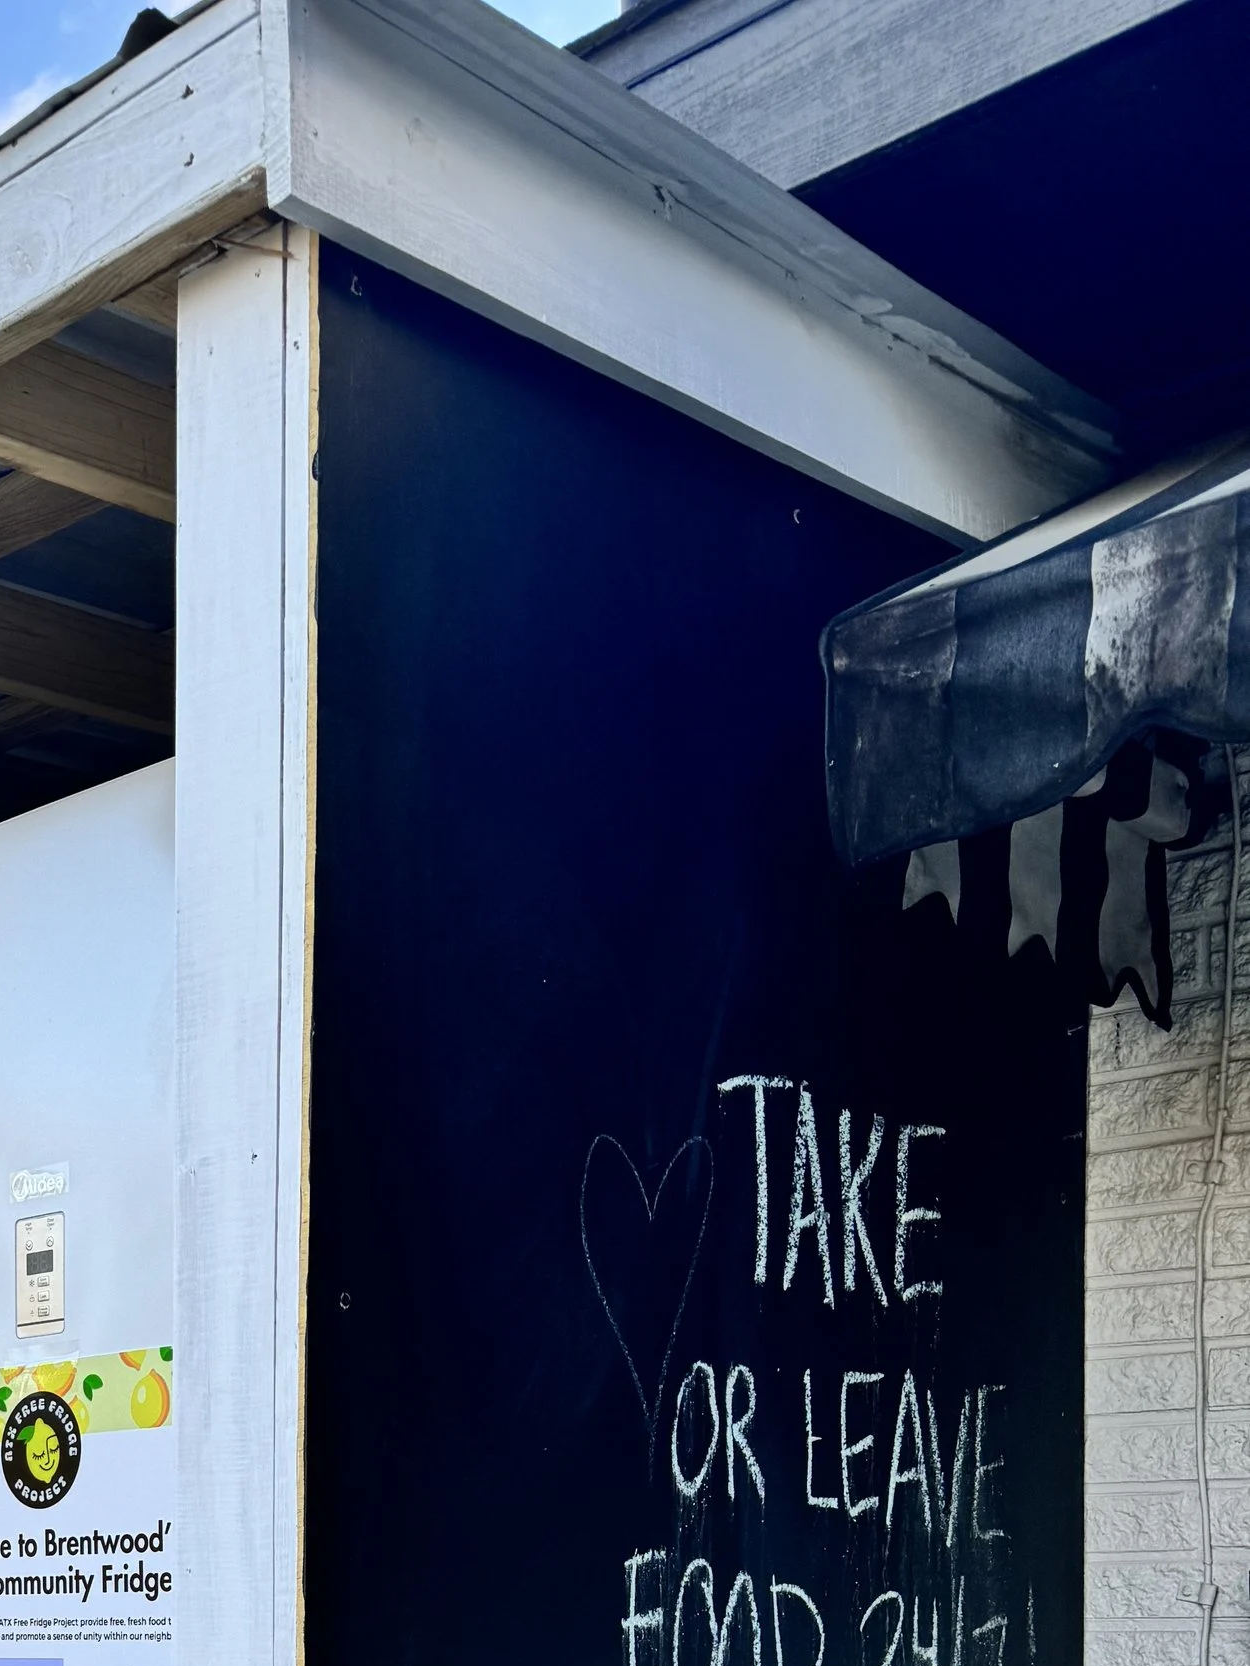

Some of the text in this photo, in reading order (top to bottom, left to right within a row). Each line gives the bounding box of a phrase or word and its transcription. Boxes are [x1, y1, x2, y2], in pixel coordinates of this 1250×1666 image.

[718, 1074, 946, 1309] TAKE
[5, 1398, 77, 1462] ATX FREE FRIDGE
[671, 1360, 1012, 1548] OR LEAVE
[14, 1475, 67, 1503] PROJECT
[18, 1534, 37, 1557] to
[101, 1560, 172, 1601] Fridge
[1, 1633, 14, 1641] and
[16, 1633, 45, 1643] promote
[83, 1633, 101, 1643] unity
[103, 1632, 128, 1640] within
[14, 1618, 28, 1627] Free
[30, 1618, 52, 1629] Fridge
[53, 1618, 79, 1629] Project
[80, 1618, 108, 1629] provide
[110, 1617, 126, 1629] free,
[127, 1617, 147, 1626] fresh
[149, 1617, 166, 1626] food
